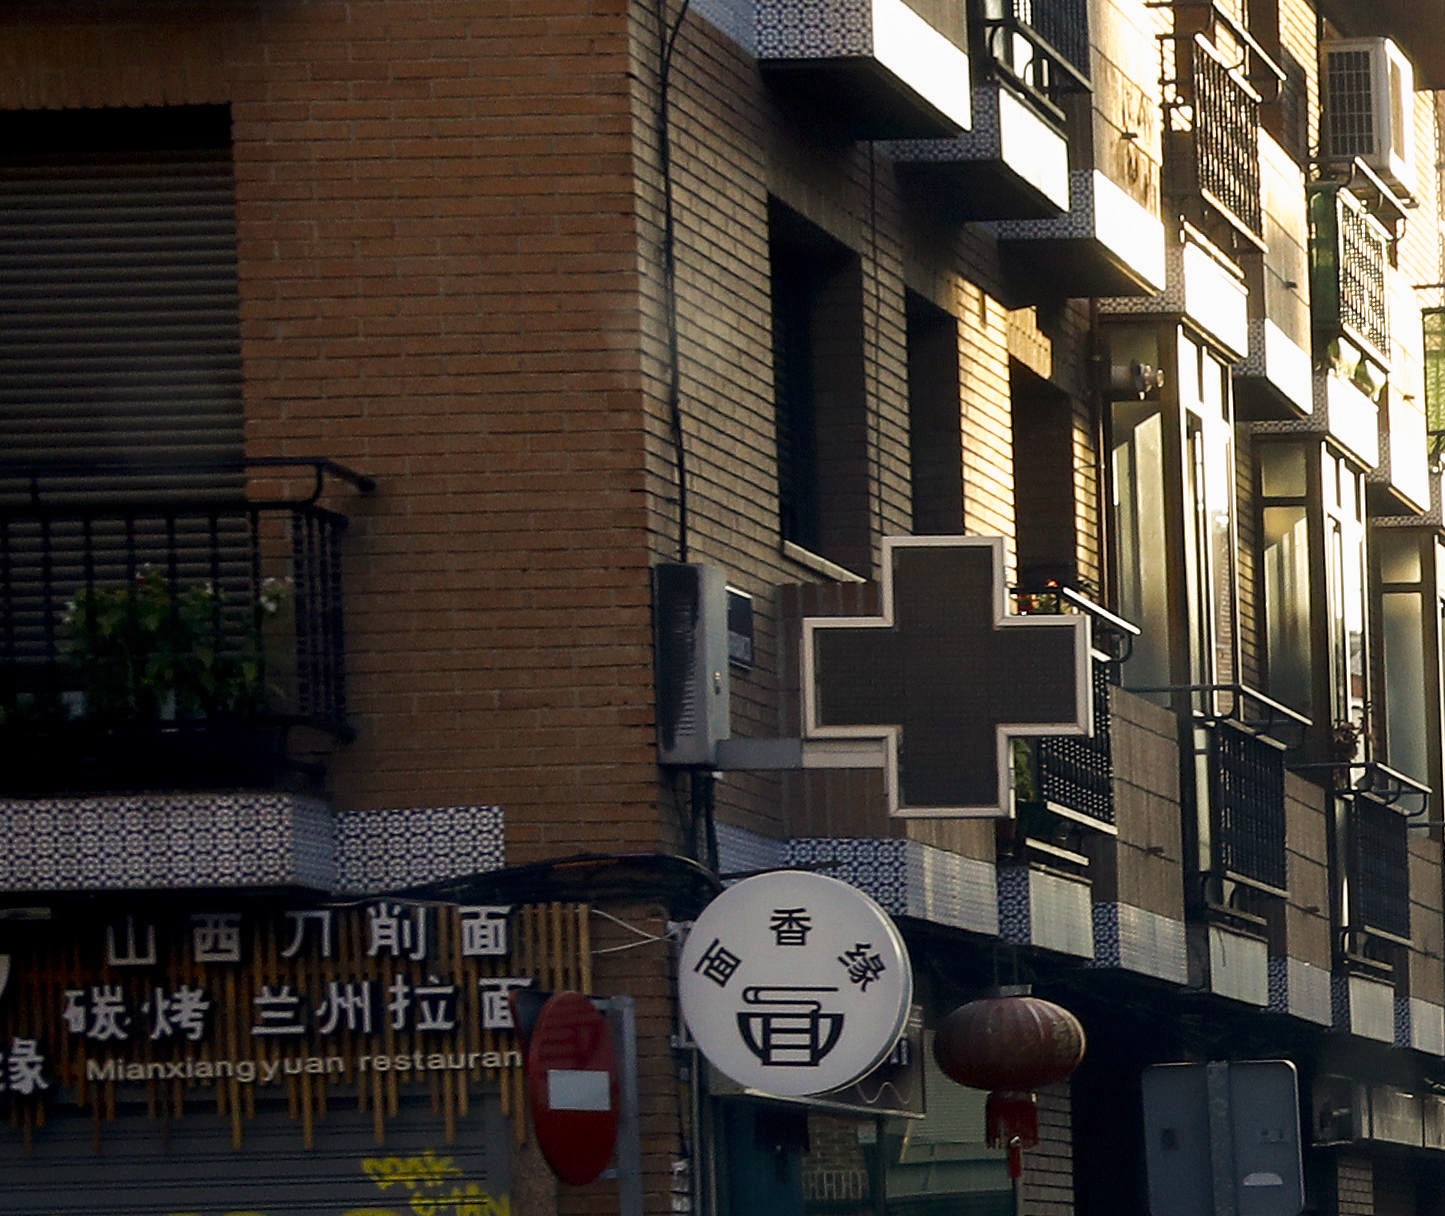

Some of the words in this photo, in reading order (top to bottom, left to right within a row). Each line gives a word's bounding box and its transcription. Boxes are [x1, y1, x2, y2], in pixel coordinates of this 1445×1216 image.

[105, 903, 512, 967] 山西刀削面
[86, 1057, 345, 1083] Mianxiangyuan
